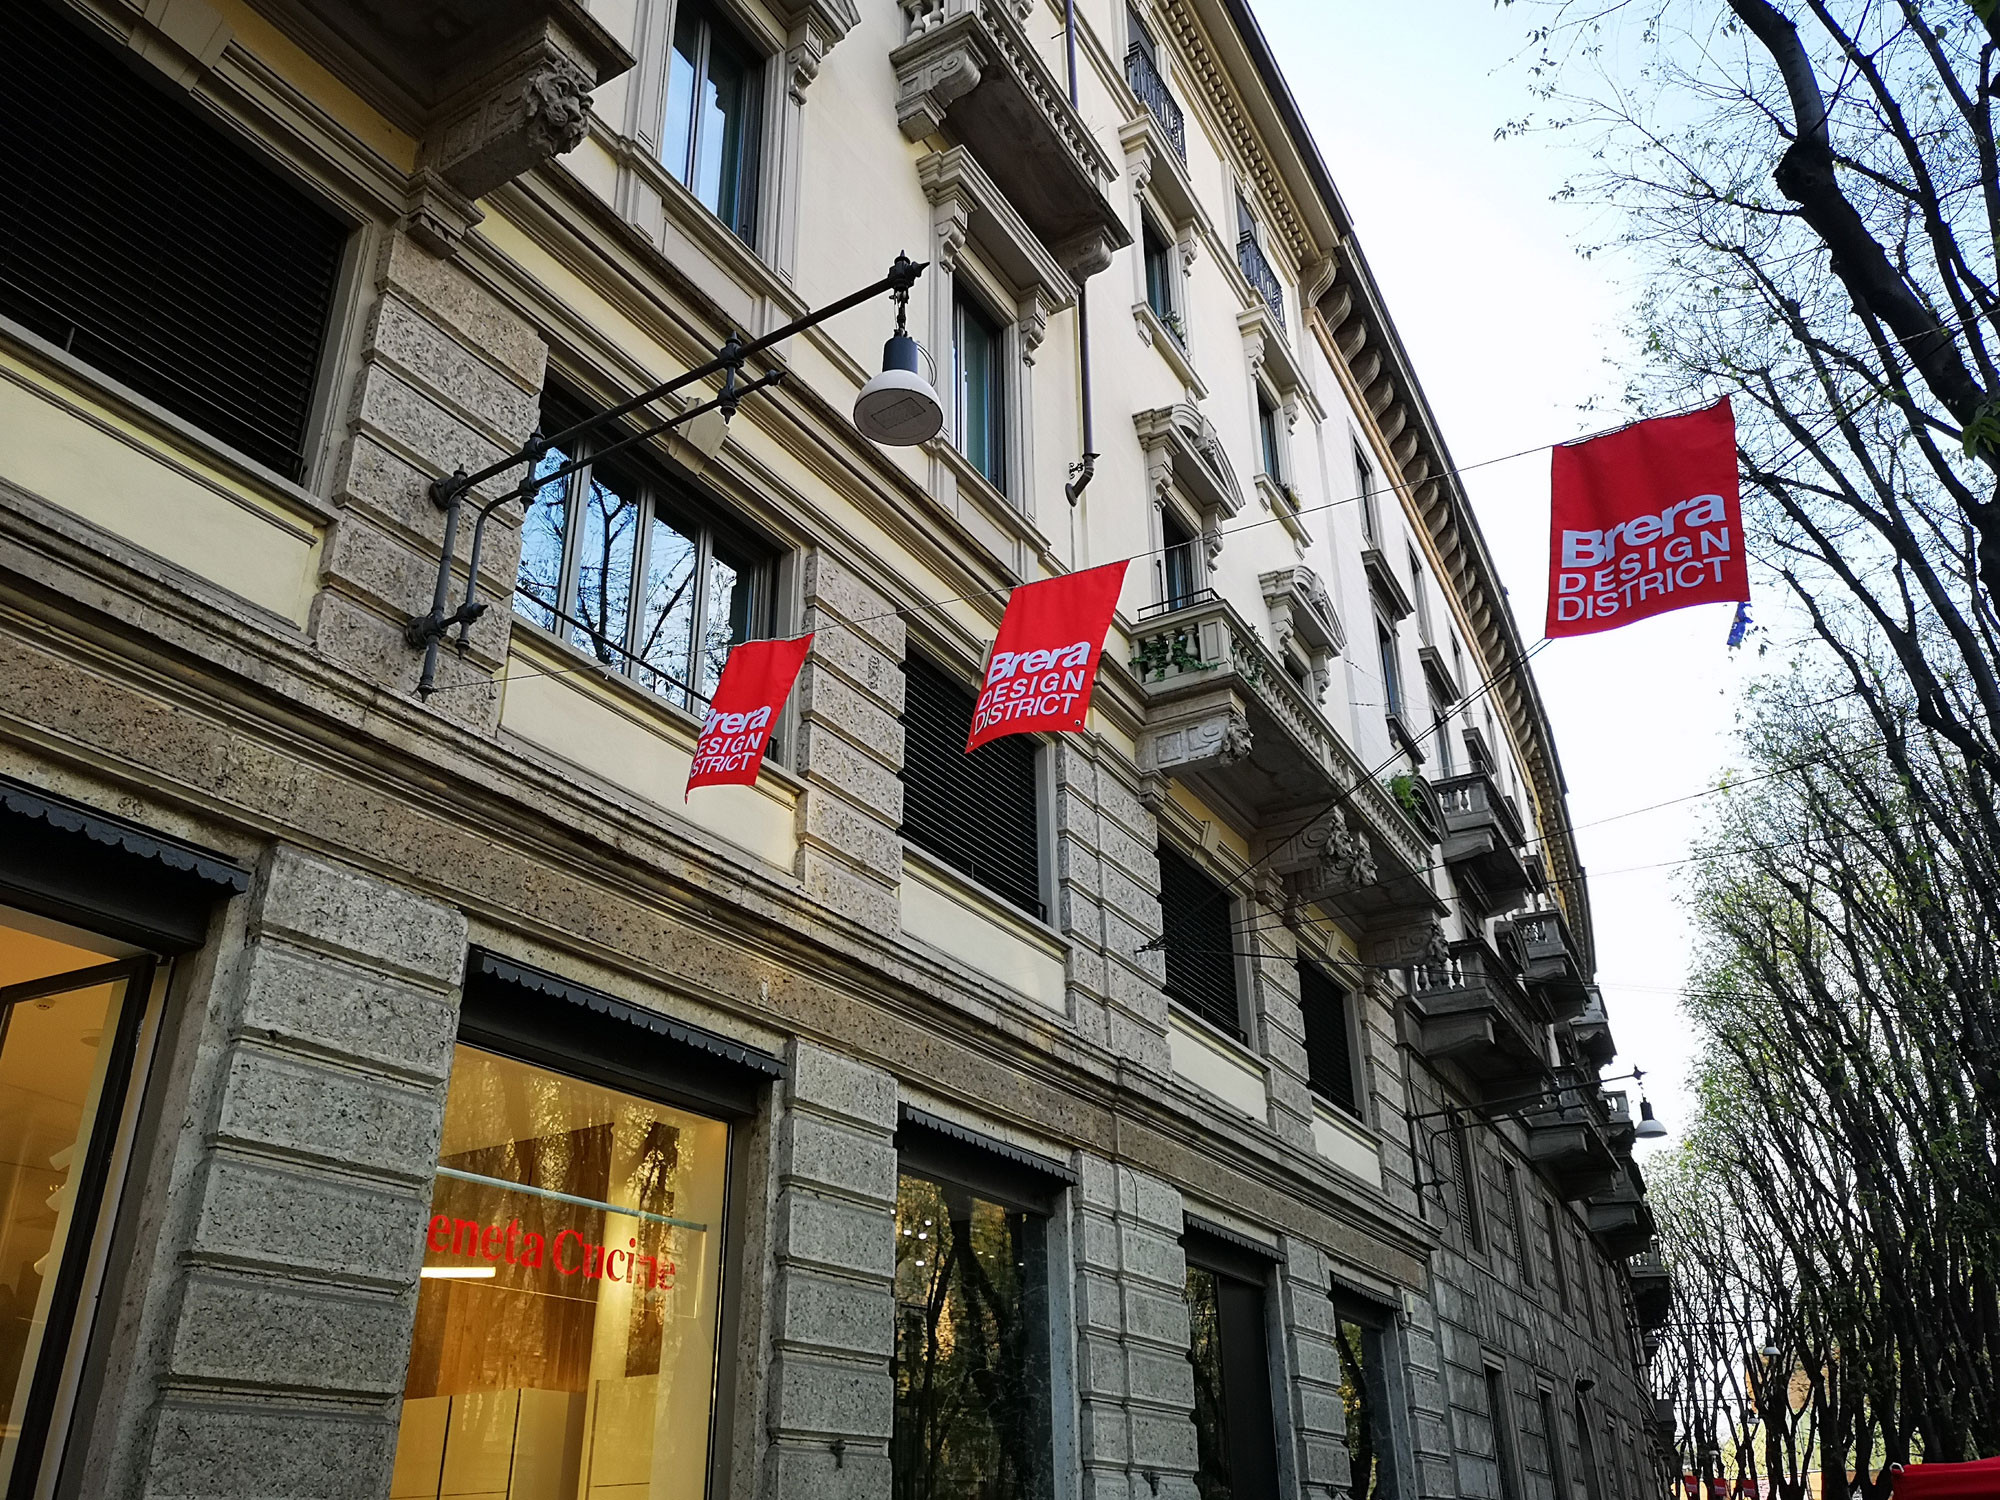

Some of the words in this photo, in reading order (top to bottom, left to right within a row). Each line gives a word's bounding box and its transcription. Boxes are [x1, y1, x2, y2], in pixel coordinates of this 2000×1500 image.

[1562, 494, 1727, 568] Brera
[1558, 527, 1730, 594] DESIGN
[1557, 556, 1731, 621] DISTRICT
[987, 641, 1091, 689] Brera
[974, 693, 1079, 736] DISTRICT
[978, 670, 1085, 712] DESIGN
[690, 752, 757, 778] STRICT
[696, 731, 764, 759] ESIGN
[427, 1214, 545, 1269] eneta
[552, 1229, 676, 1290] Cucine
